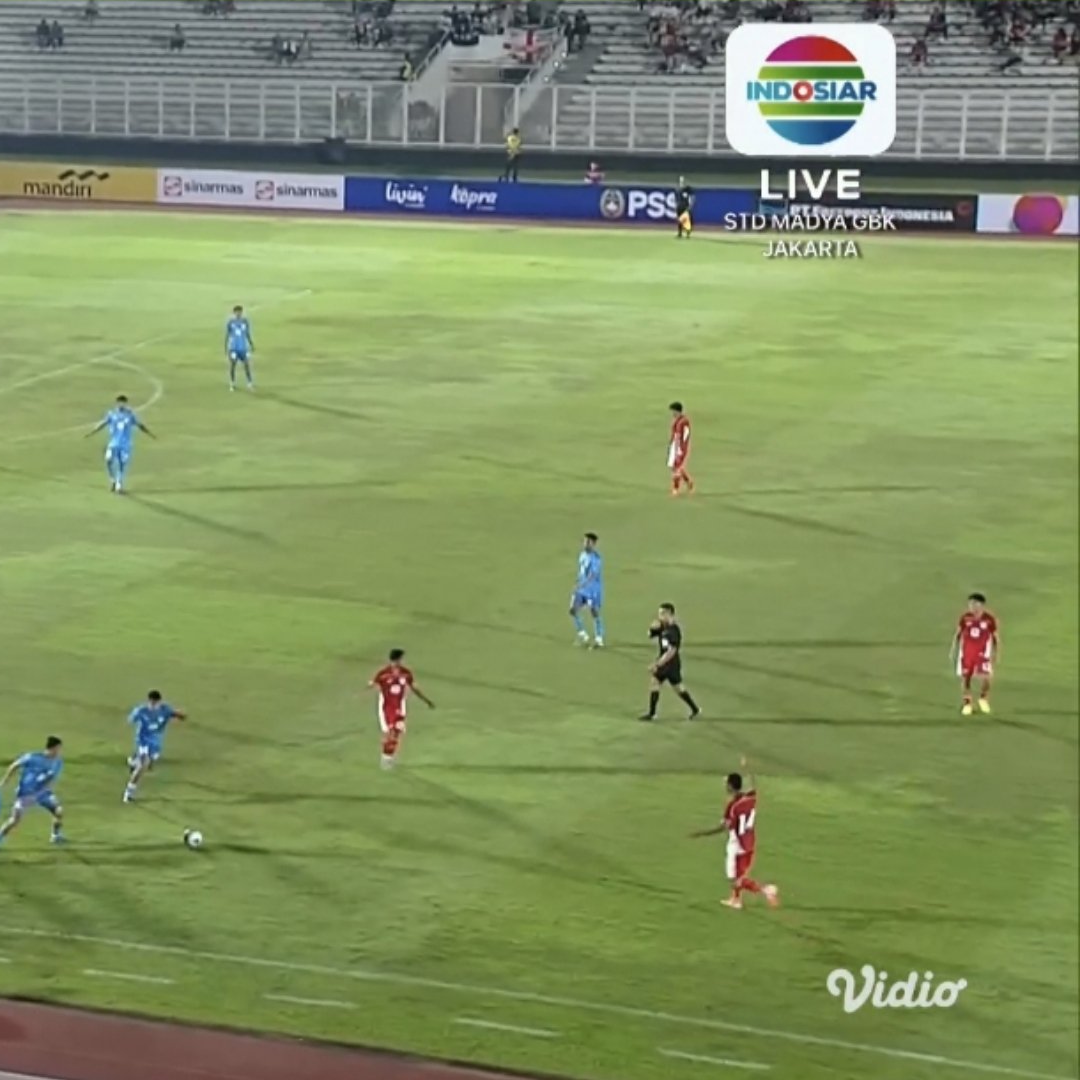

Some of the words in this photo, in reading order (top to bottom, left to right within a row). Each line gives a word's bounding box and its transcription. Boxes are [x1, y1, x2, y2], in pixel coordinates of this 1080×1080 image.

[23, 179, 92, 199] mandiri
[183, 180, 245, 195] sinarmas
[275, 183, 338, 199] sinarmas
